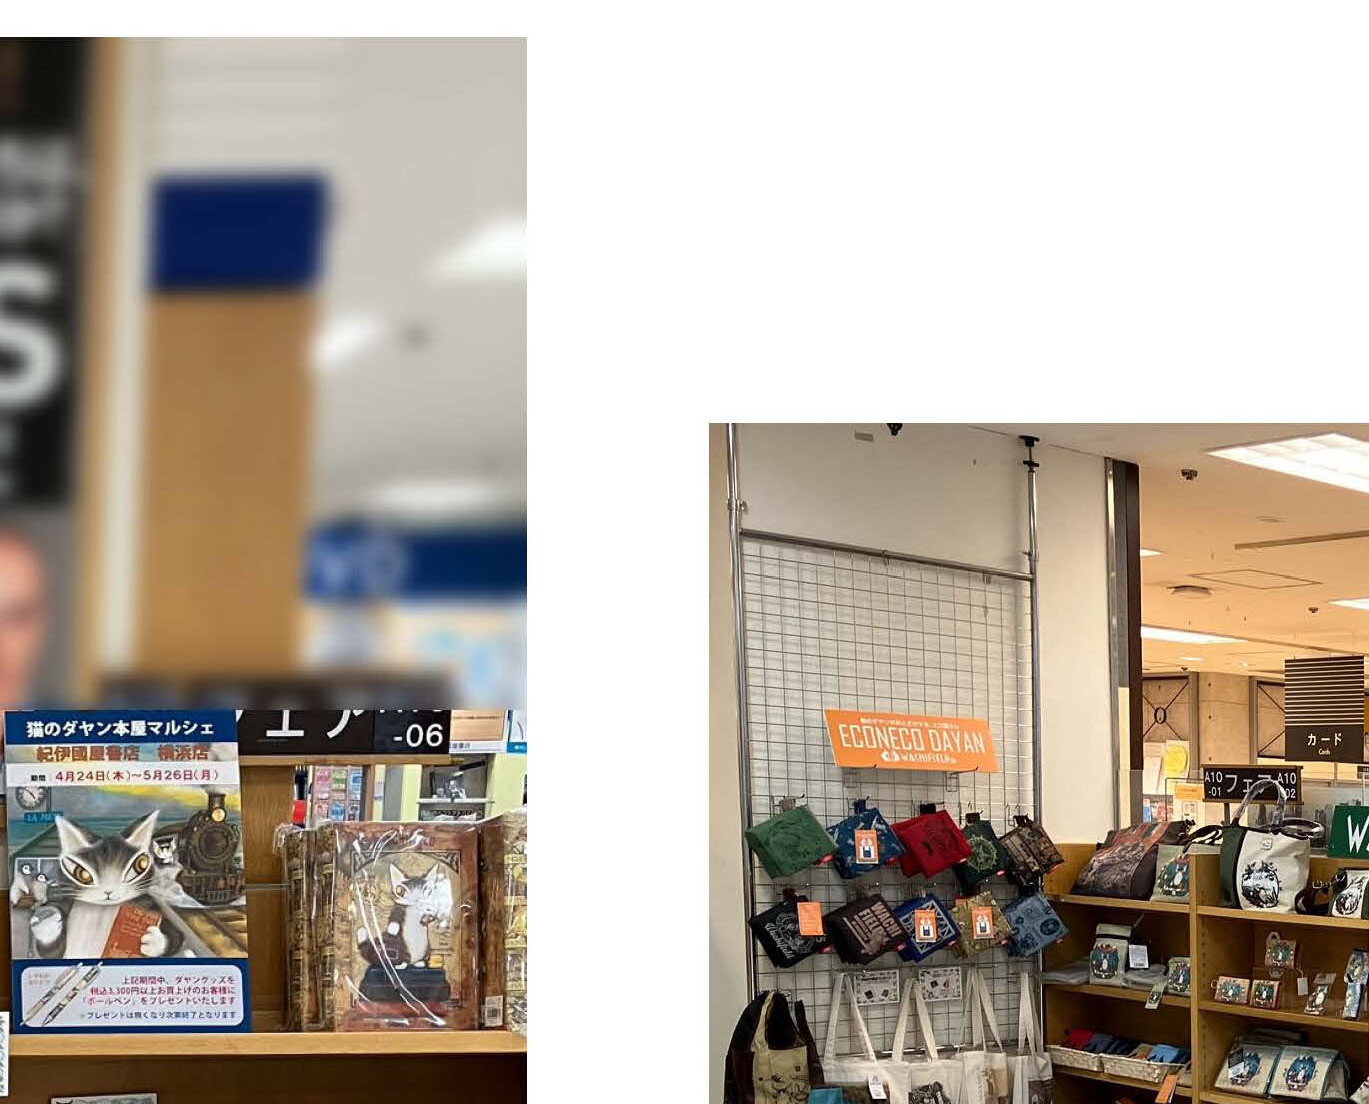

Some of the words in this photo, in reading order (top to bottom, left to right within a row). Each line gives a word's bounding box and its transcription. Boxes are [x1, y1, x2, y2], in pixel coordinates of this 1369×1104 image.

[26, 720, 214, 738] 猫のダヤン本屋マルシェ
[393, 723, 444, 748] -06
[838, 723, 924, 750] ECONECO
[929, 728, 986, 754] DAYAN
[1307, 732, 1342, 747] カード
[37, 745, 140, 762] 紀伊國屋書店
[158, 744, 209, 761] 横浜店
[1204, 771, 1223, 783] A10
[1208, 788, 1222, 797] -01
[871, 901, 904, 938] WACHI
